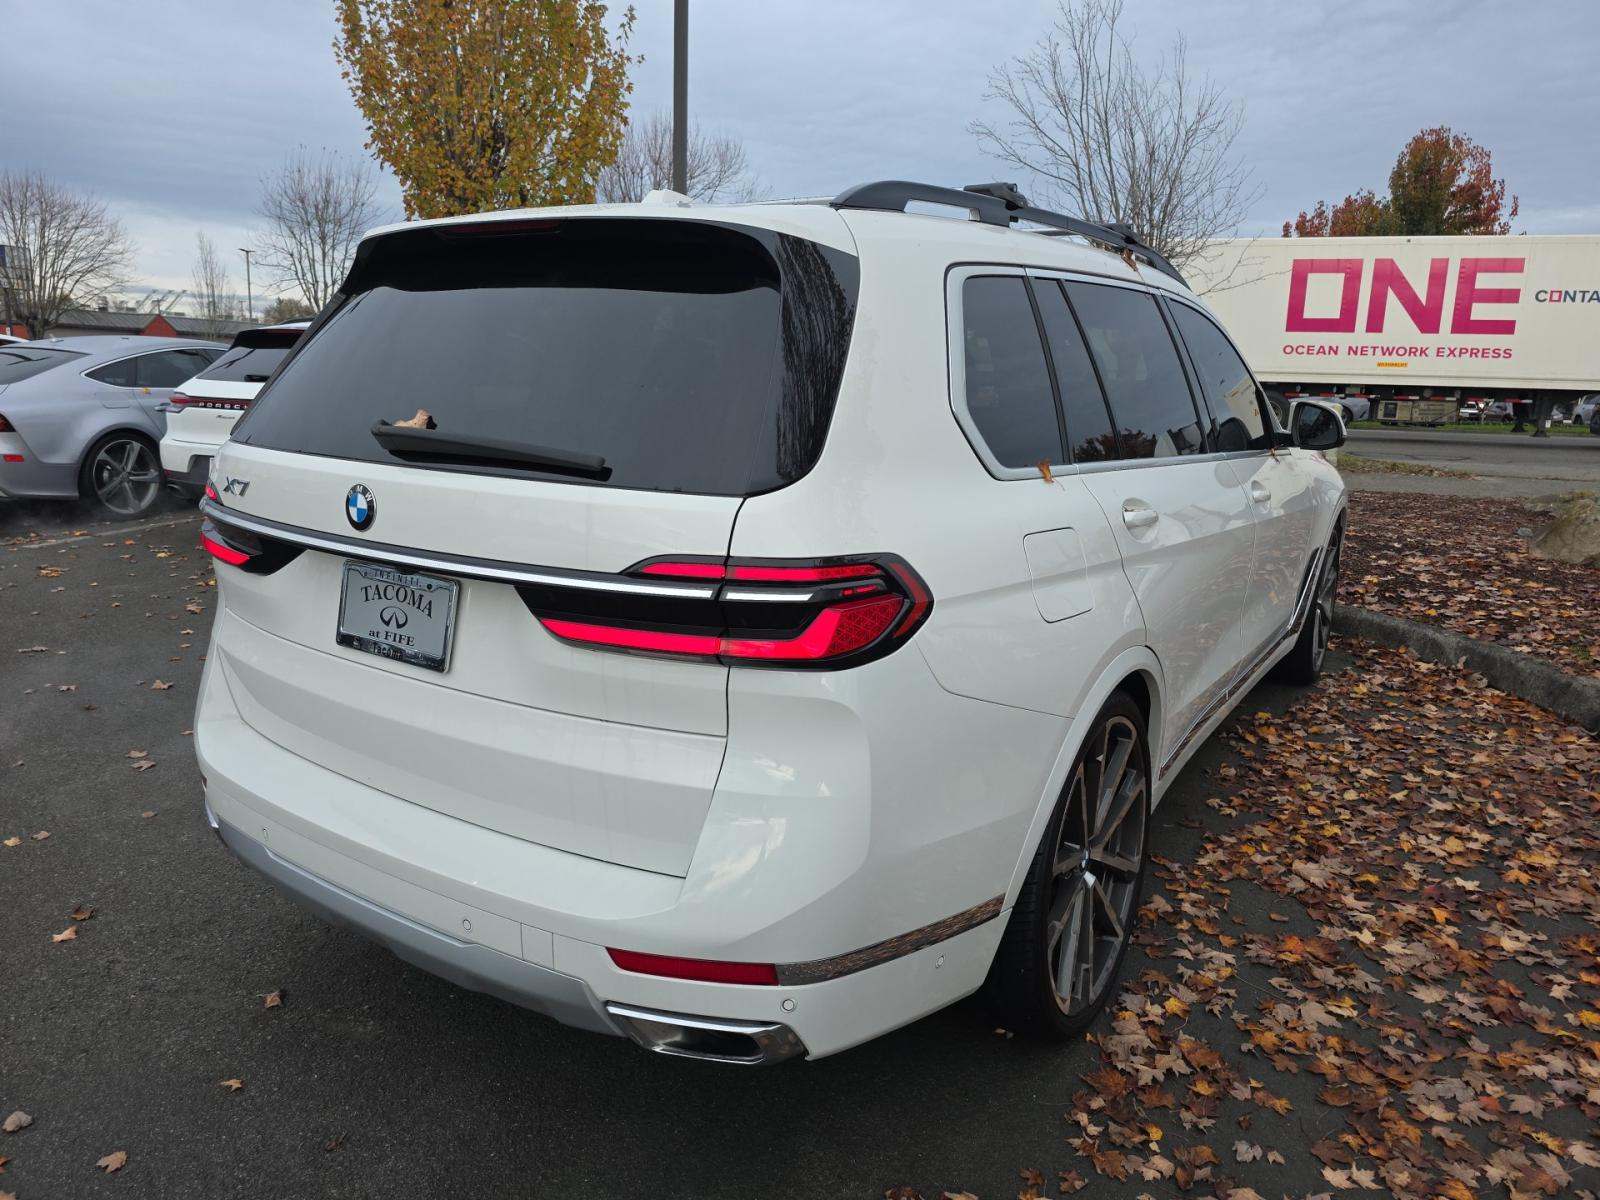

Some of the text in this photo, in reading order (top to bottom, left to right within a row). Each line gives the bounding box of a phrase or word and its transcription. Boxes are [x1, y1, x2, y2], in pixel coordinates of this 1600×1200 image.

[1285, 257, 1526, 335] ONE
[1534, 289, 1600, 303] CONTA
[1282, 344, 1513, 359] OCEAN NETWORK EXPRESS
[223, 476, 250, 497] X7
[360, 583, 433, 620] TACOMA
[368, 630, 415, 647] at FIFE
